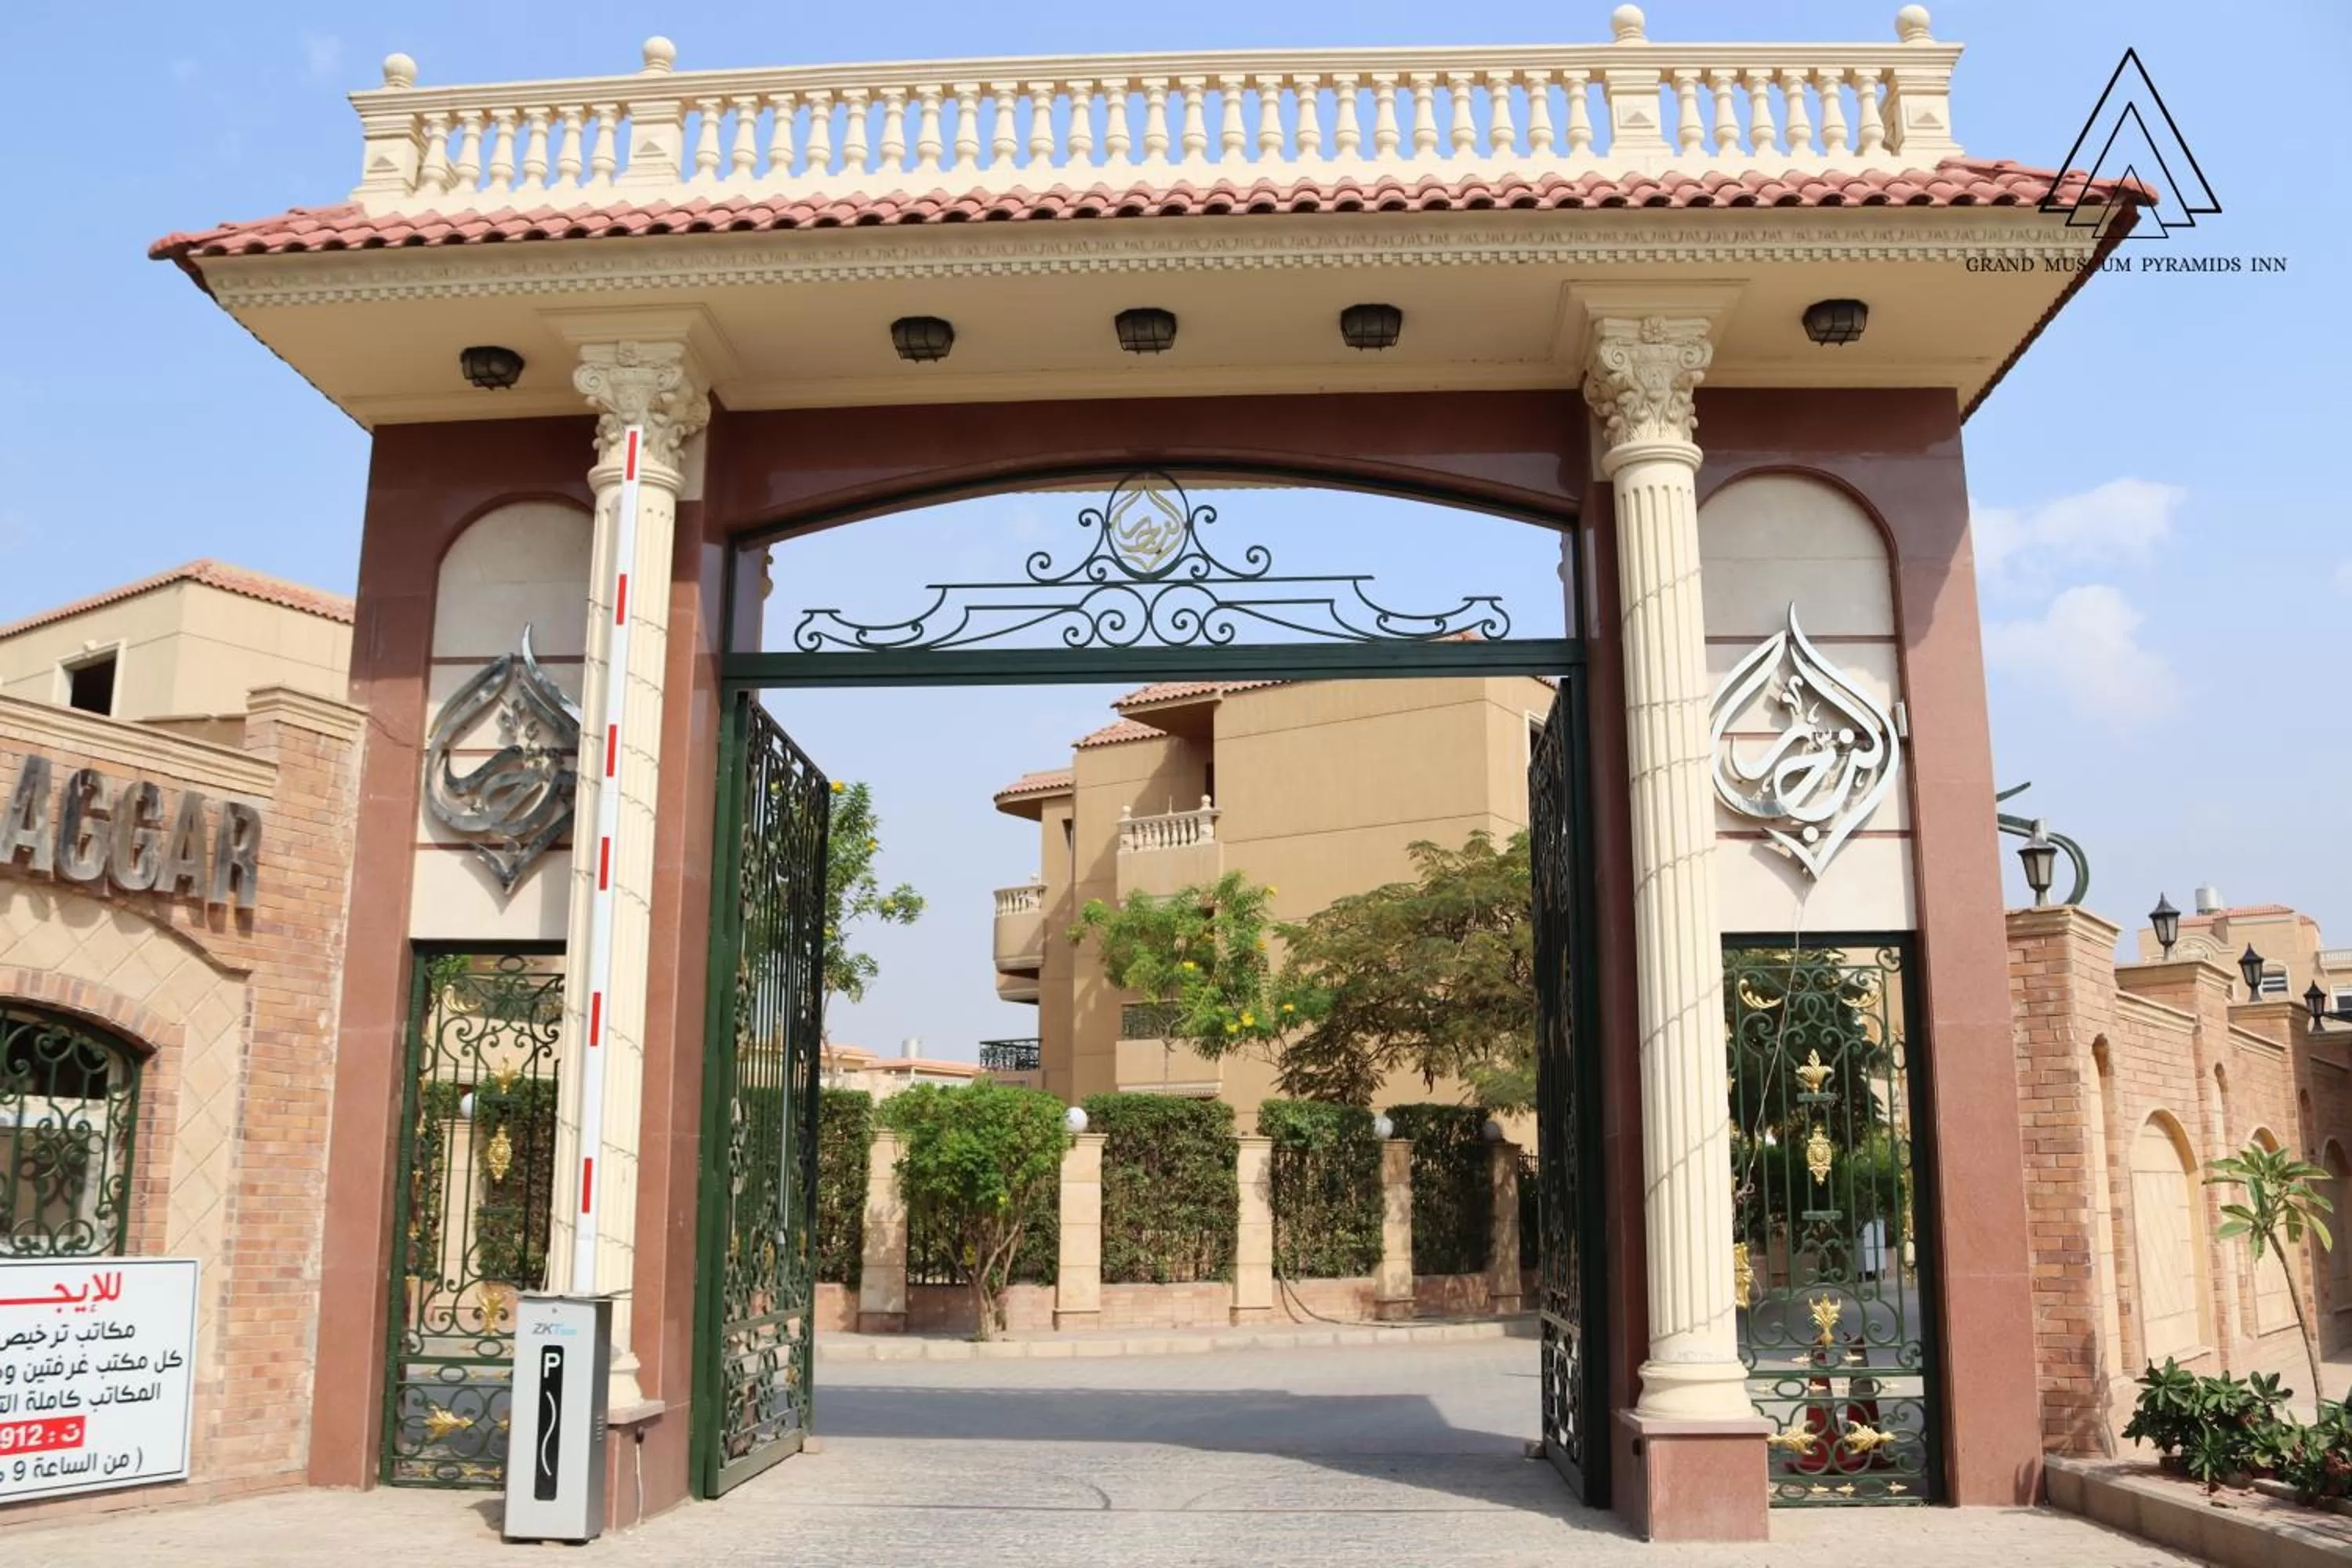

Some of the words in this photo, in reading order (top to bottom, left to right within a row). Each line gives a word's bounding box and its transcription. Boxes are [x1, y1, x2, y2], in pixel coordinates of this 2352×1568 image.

[75, 1321, 136, 1348] مكاتب
[24, 1353, 89, 1384] غرفتين
[96, 1352, 148, 1380] مكتب
[154, 1349, 183, 1374] كل
[543, 1352, 561, 1378] P
[26, 1389, 82, 1411] كاملة
[89, 1382, 162, 1413] المكاتب
[13, 1460, 26, 1481] 9
[34, 1453, 97, 1478] الساعة
